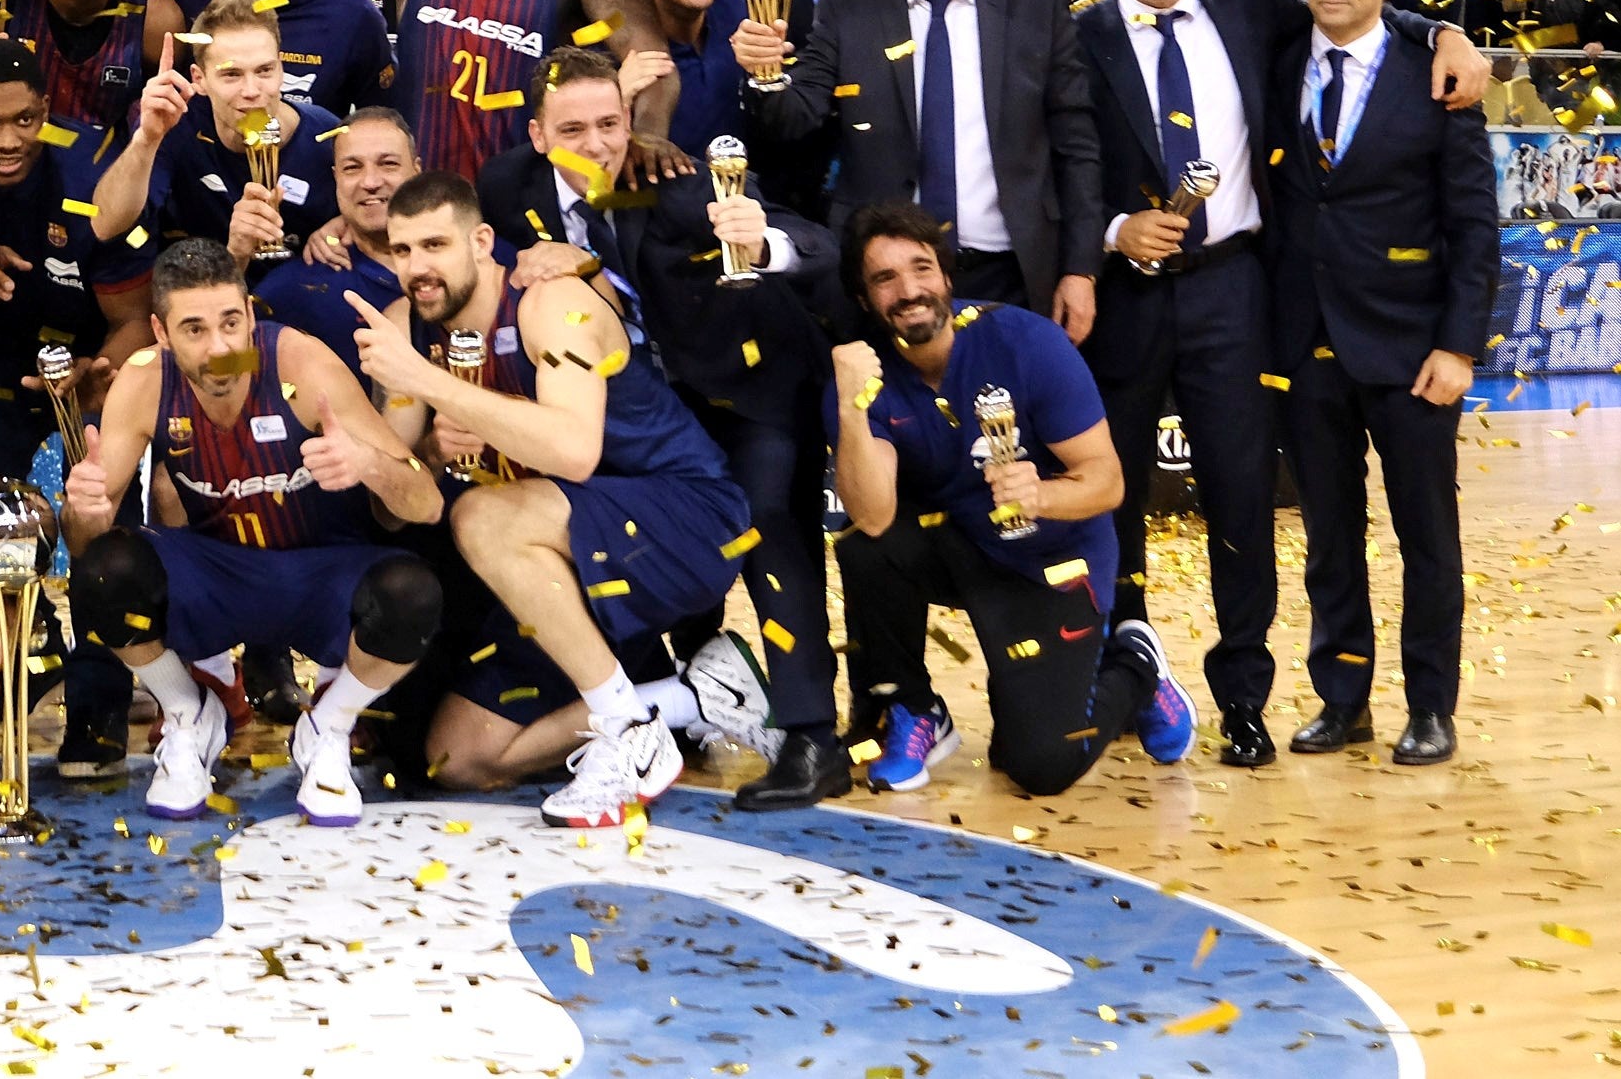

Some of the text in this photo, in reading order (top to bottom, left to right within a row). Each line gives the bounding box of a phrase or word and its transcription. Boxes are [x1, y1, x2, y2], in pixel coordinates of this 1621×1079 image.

[443, 8, 544, 52] LASSA
[450, 50, 488, 107] 21
[227, 512, 267, 548] 11
